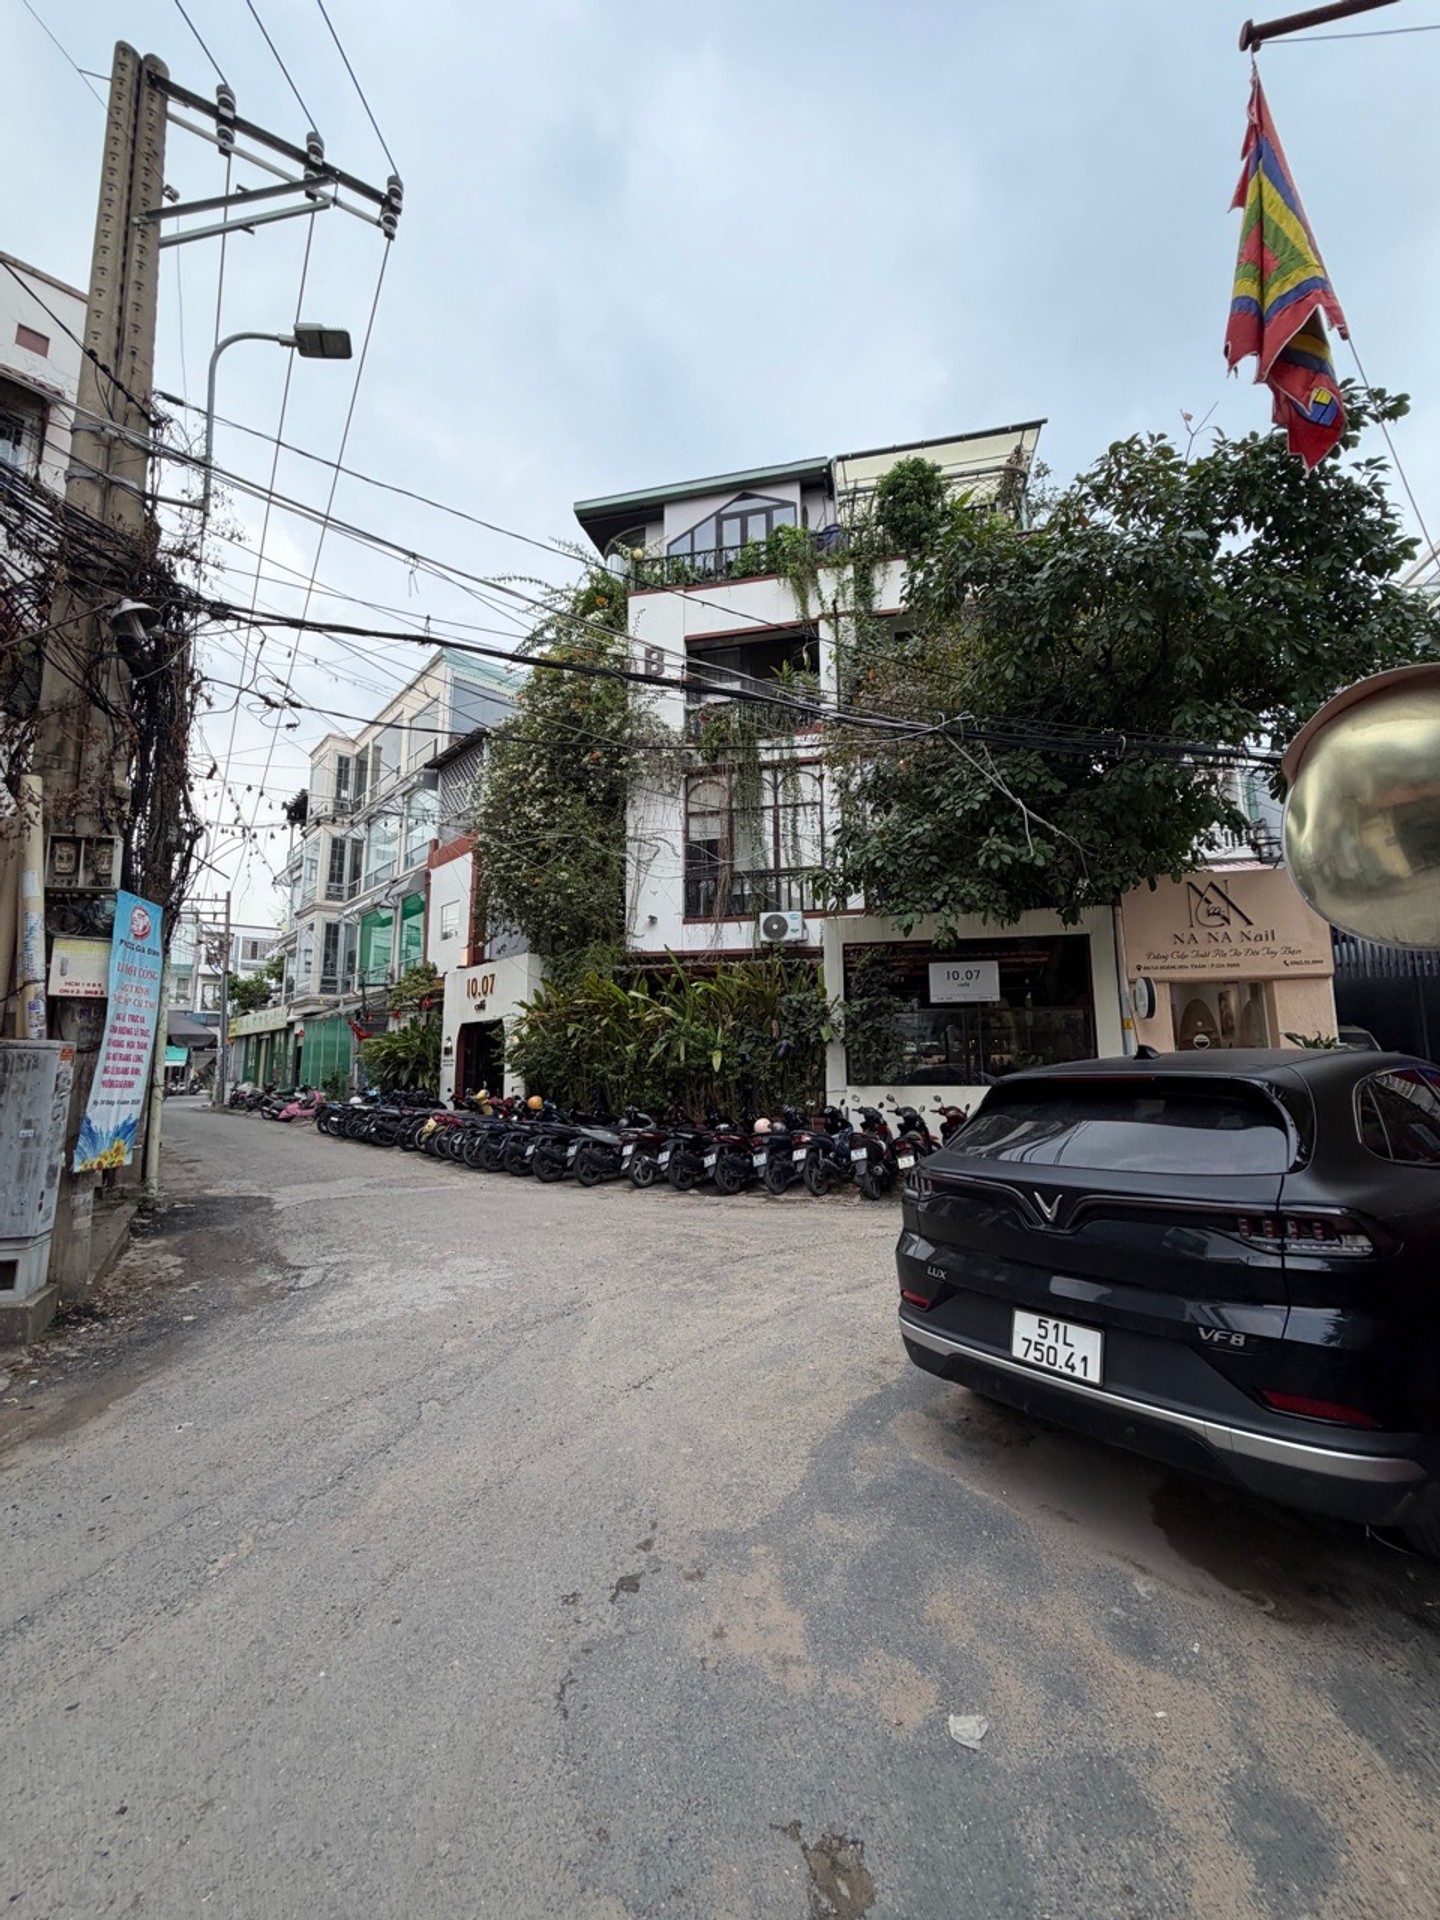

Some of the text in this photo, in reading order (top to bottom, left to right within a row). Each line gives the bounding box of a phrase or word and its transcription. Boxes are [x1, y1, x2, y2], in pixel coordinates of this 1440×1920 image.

[1173, 929, 1275, 945] NA NA Nail
[946, 969, 981, 981] 10.07
[466, 973, 496, 999] 10.07
[927, 1266, 948, 1280] LUX
[1037, 1318, 1075, 1348] 51L
[1199, 1326, 1246, 1347] VF8
[1021, 1336, 1089, 1377] 750.41
